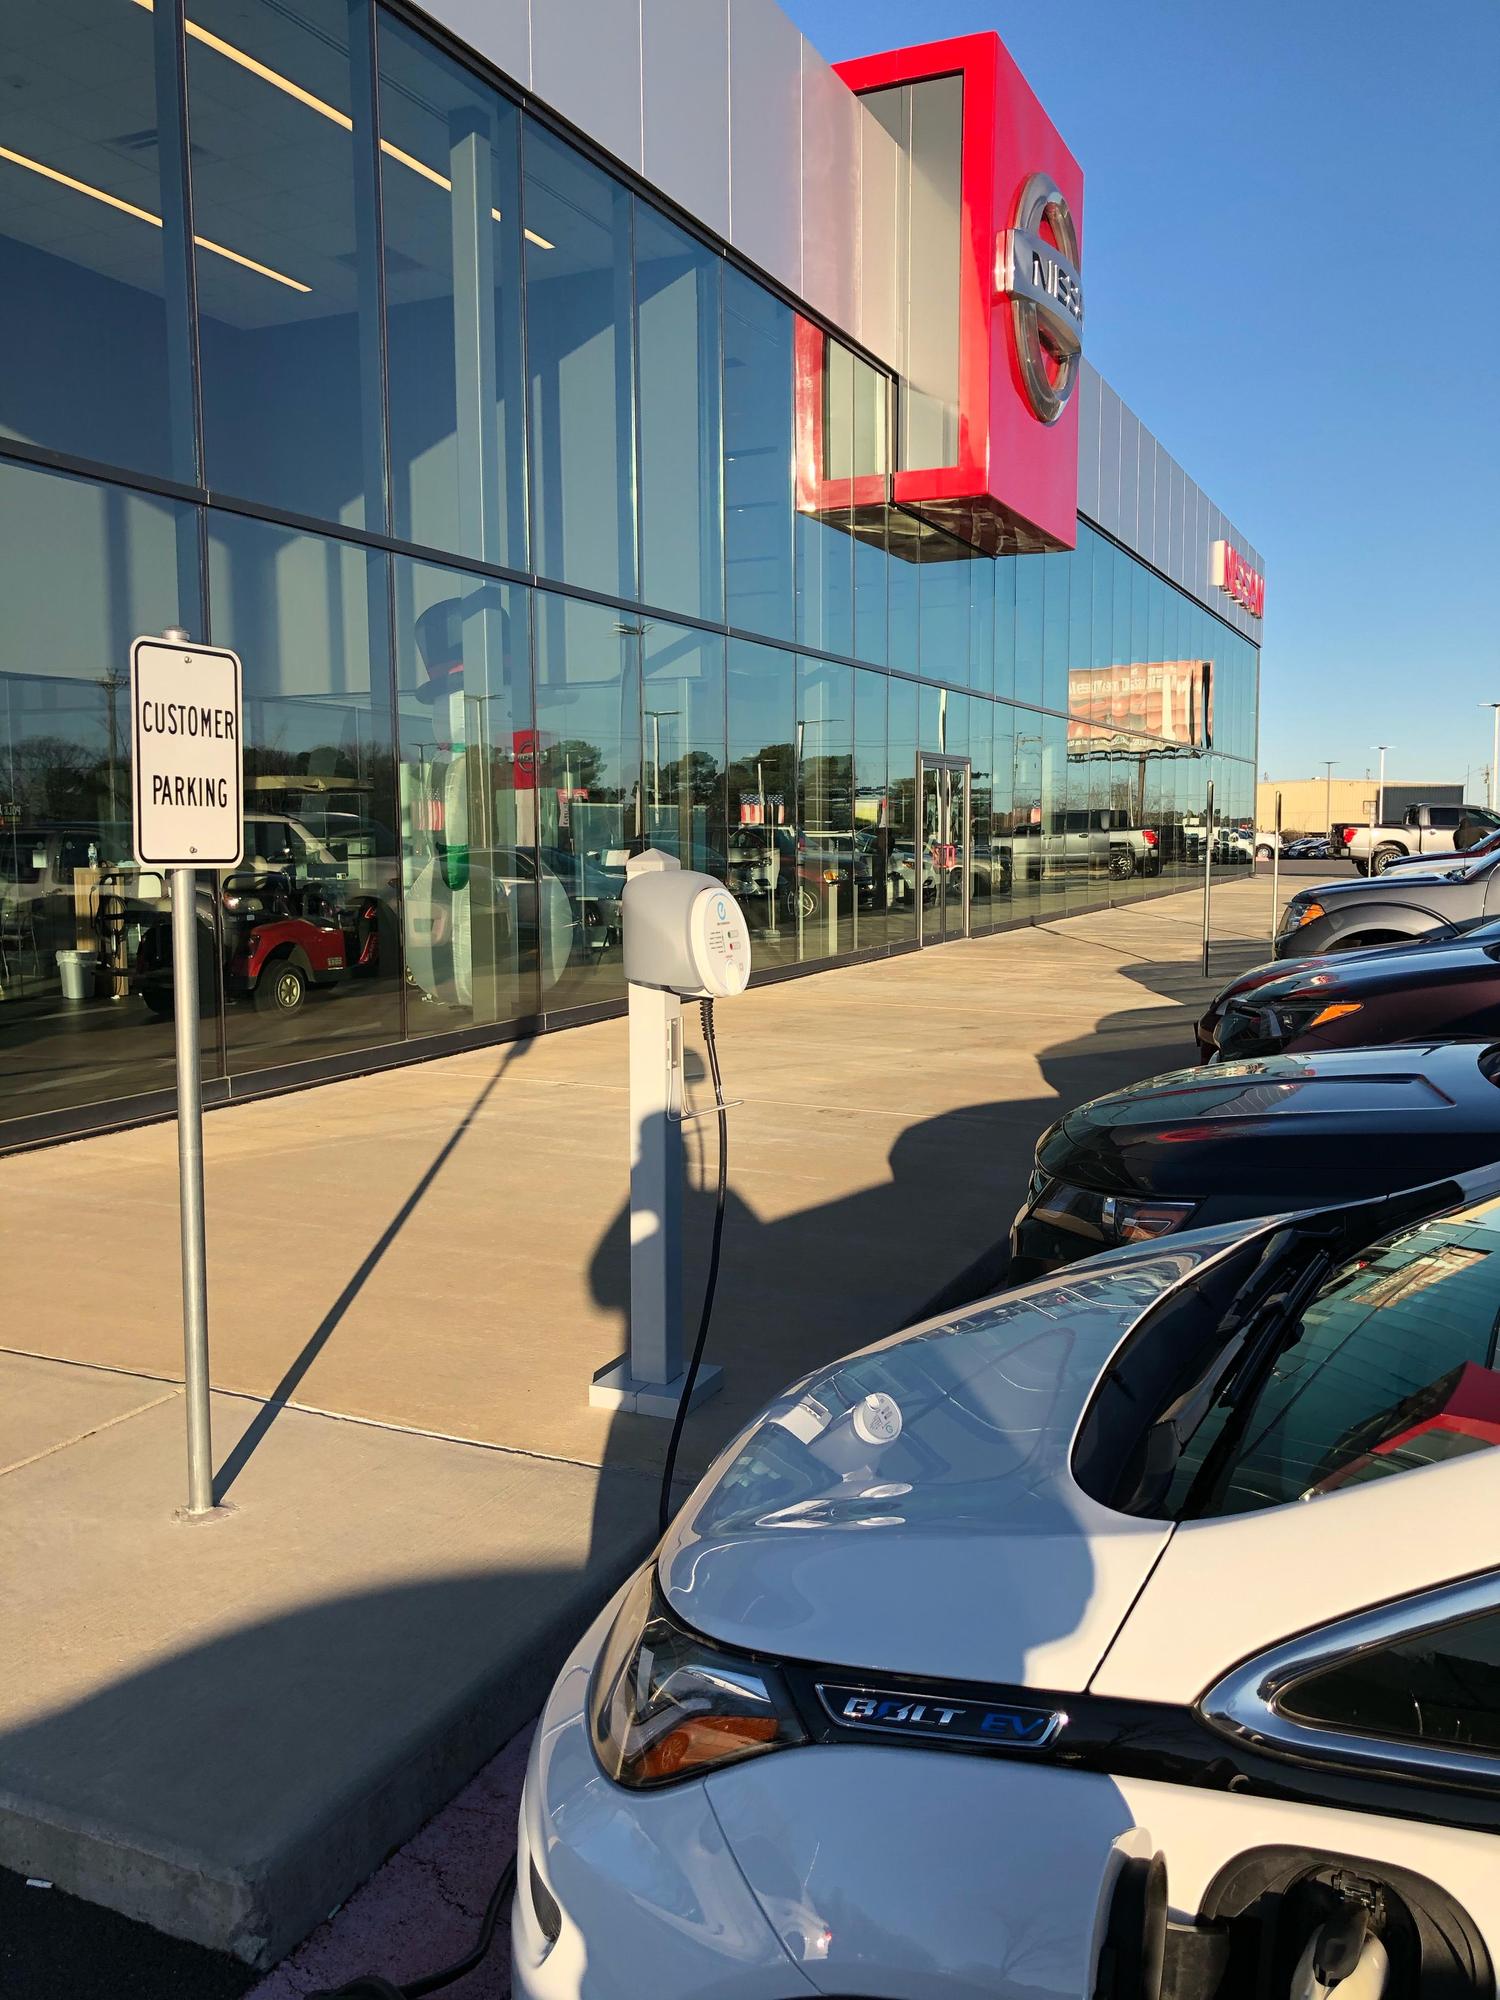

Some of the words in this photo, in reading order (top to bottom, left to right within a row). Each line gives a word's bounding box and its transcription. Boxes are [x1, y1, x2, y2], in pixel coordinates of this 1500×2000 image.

[1032, 251, 1083, 324] NISS
[1221, 540, 1265, 618] NISSAN
[142, 701, 235, 740] CUSTOMER
[152, 774, 228, 808] PARKING
[843, 1697, 967, 1728] BOLT
[979, 1713, 1045, 1738] EV
